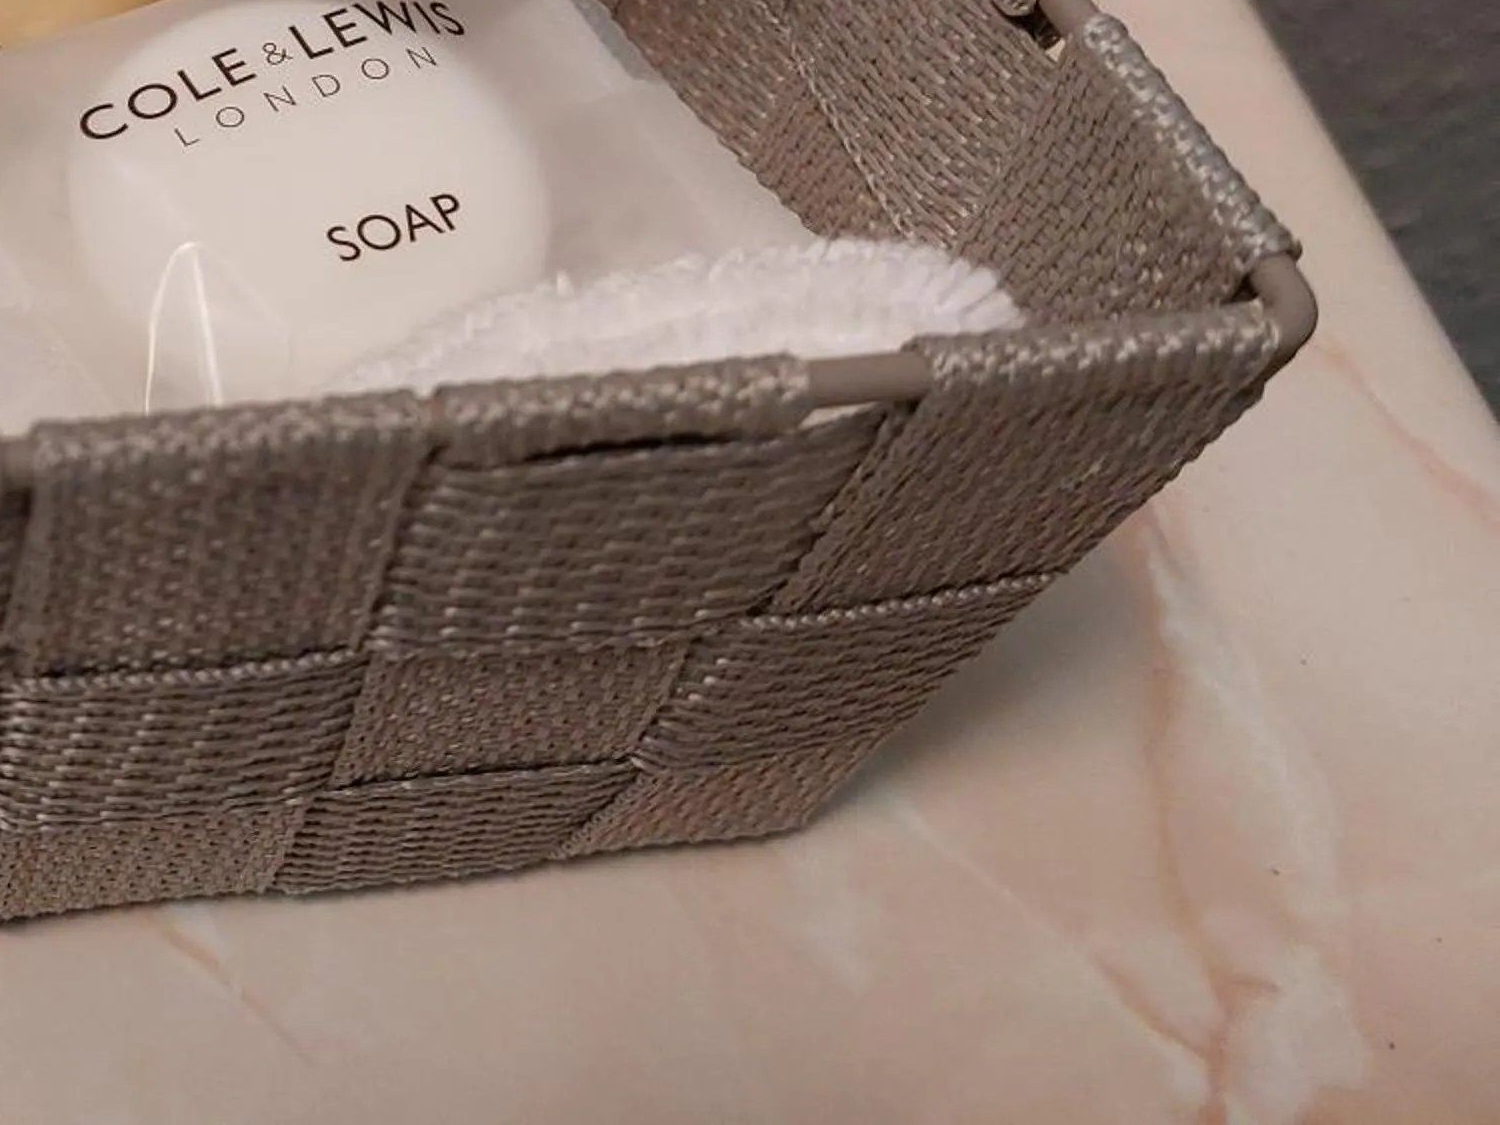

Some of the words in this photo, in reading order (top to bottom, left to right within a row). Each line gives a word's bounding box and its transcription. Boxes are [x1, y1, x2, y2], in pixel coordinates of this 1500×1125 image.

[79, 48, 257, 140] COLE
[288, 0, 465, 60] LEWIS
[173, 46, 437, 147] LONDON
[326, 193, 460, 261] SOAP
